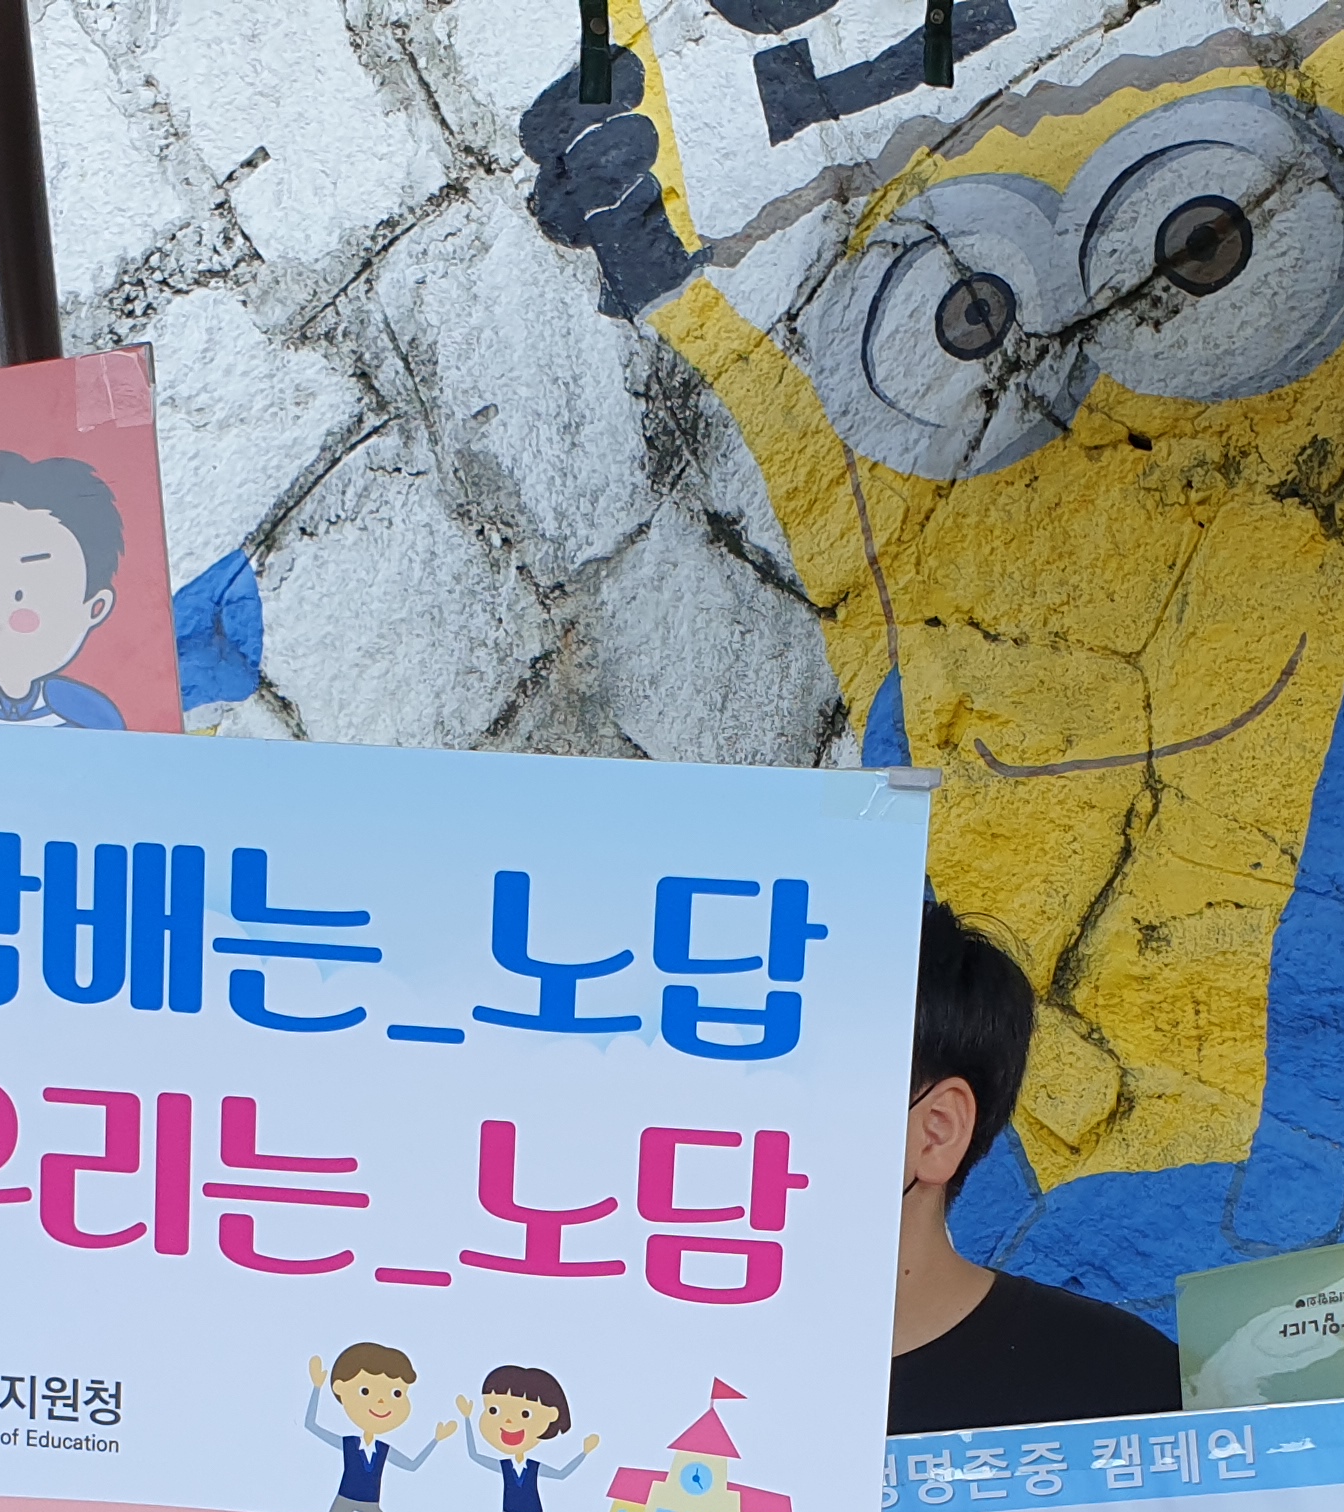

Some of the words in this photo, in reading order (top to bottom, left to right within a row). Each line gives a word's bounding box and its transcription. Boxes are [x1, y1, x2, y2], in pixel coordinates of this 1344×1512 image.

[0, 1426, 20, 1446] of
[25, 1429, 120, 1454] Education
[1092, 1424, 1257, 1489] 캠페인
